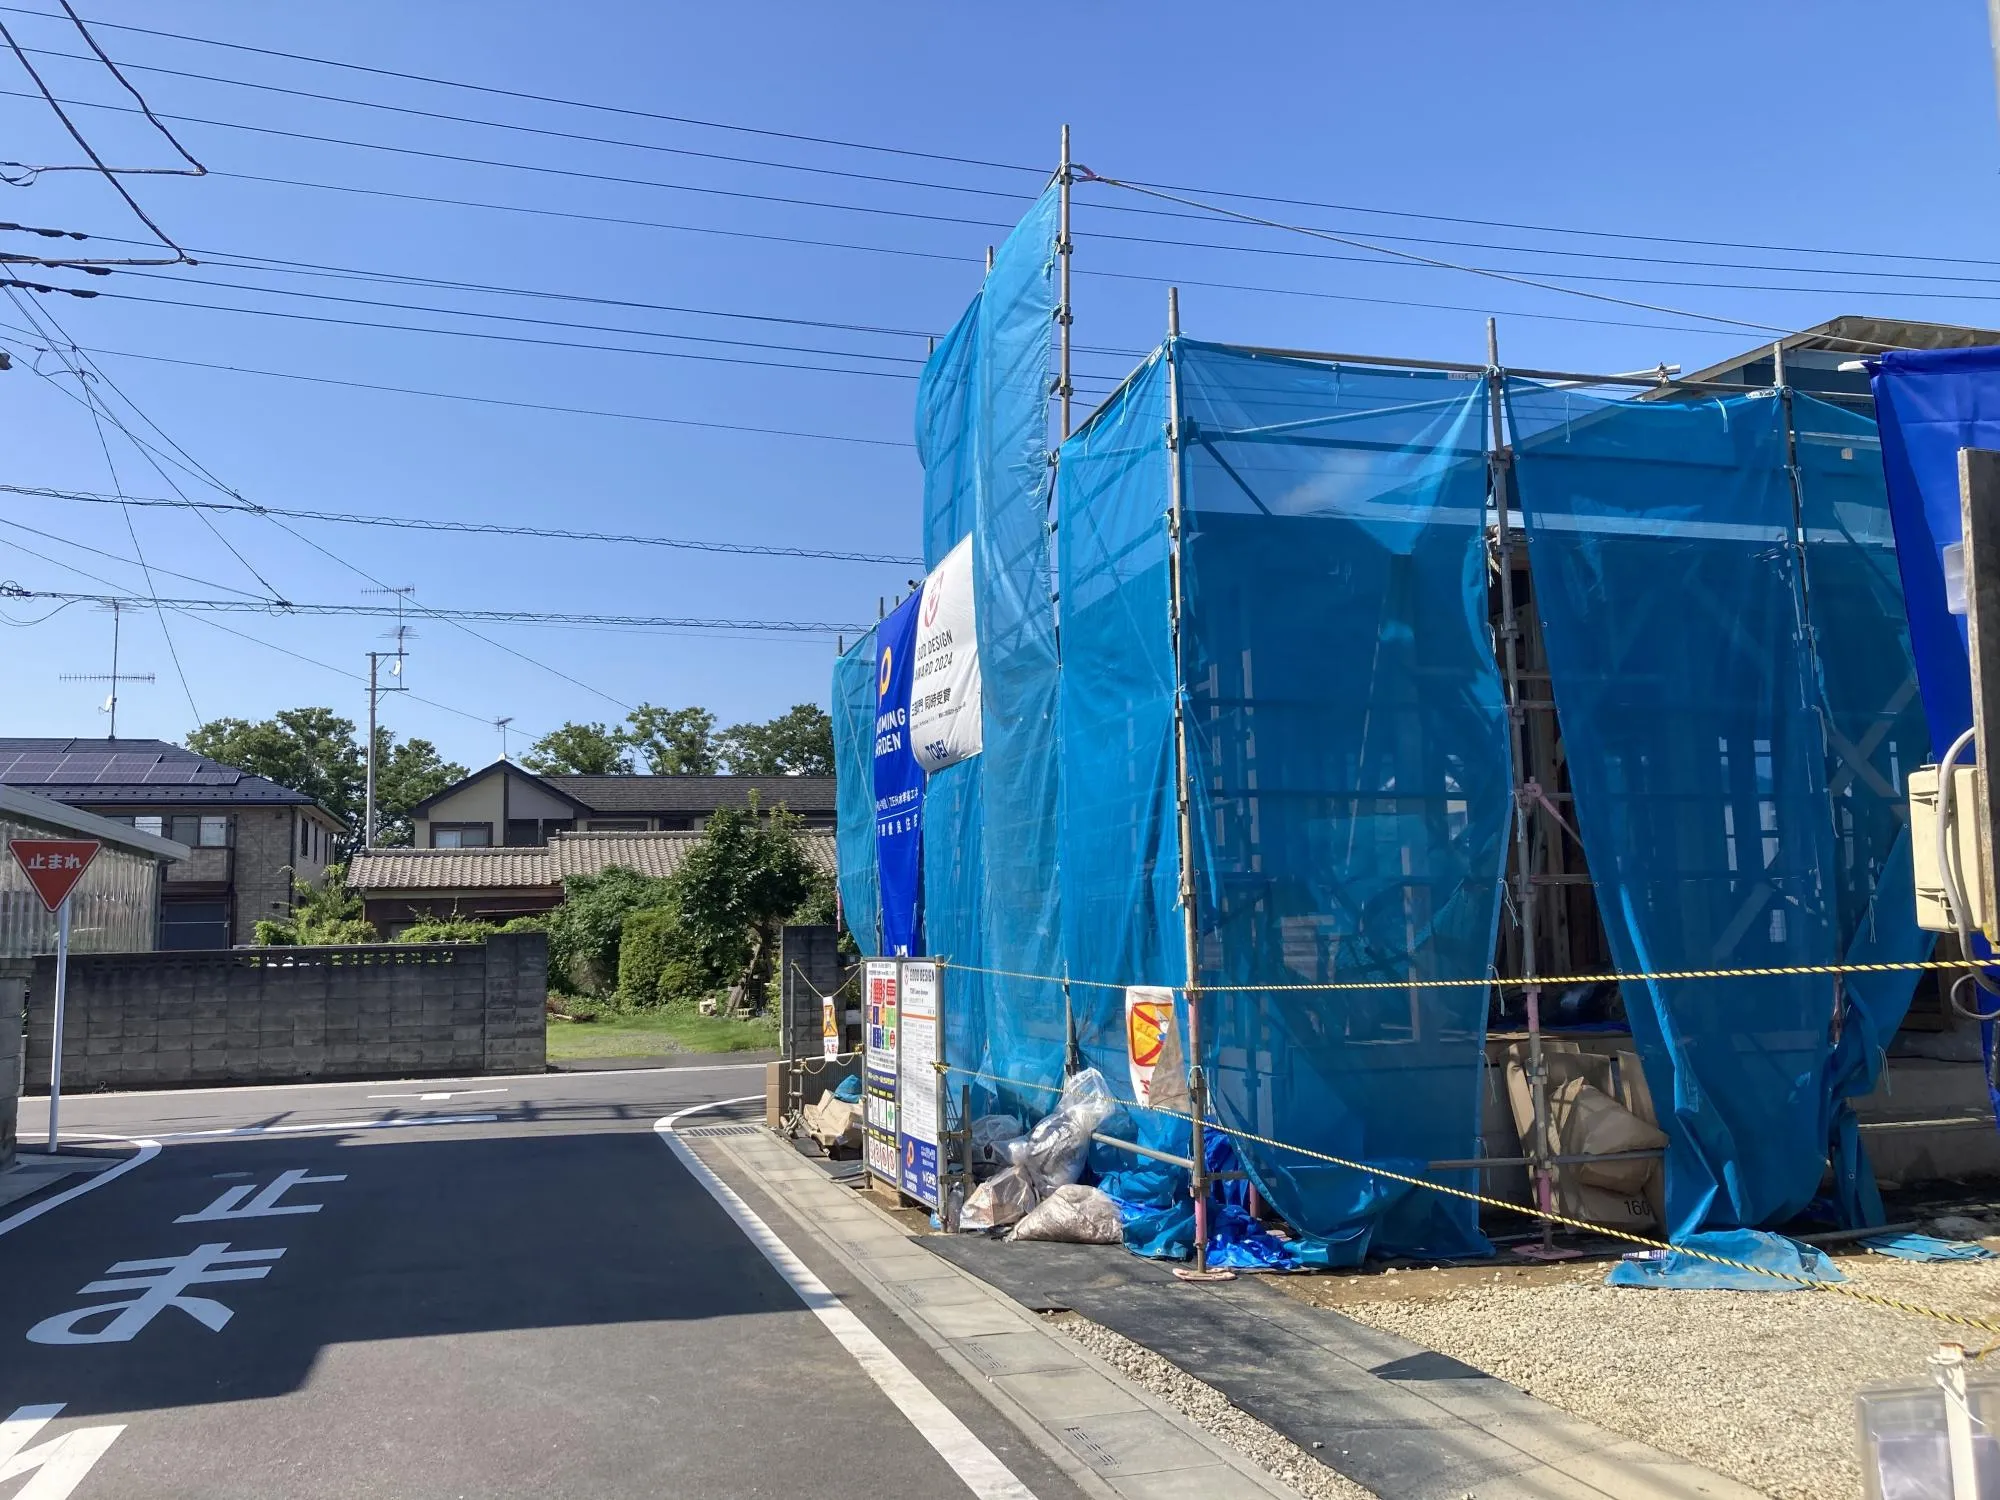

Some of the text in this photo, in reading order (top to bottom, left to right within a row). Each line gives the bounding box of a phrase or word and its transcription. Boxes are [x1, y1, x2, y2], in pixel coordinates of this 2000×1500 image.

[928, 629, 953, 655] DESIGN
[934, 651, 953, 672] 2024
[925, 739, 950, 761] TOEI
[28, 853, 82, 870] 止まれ
